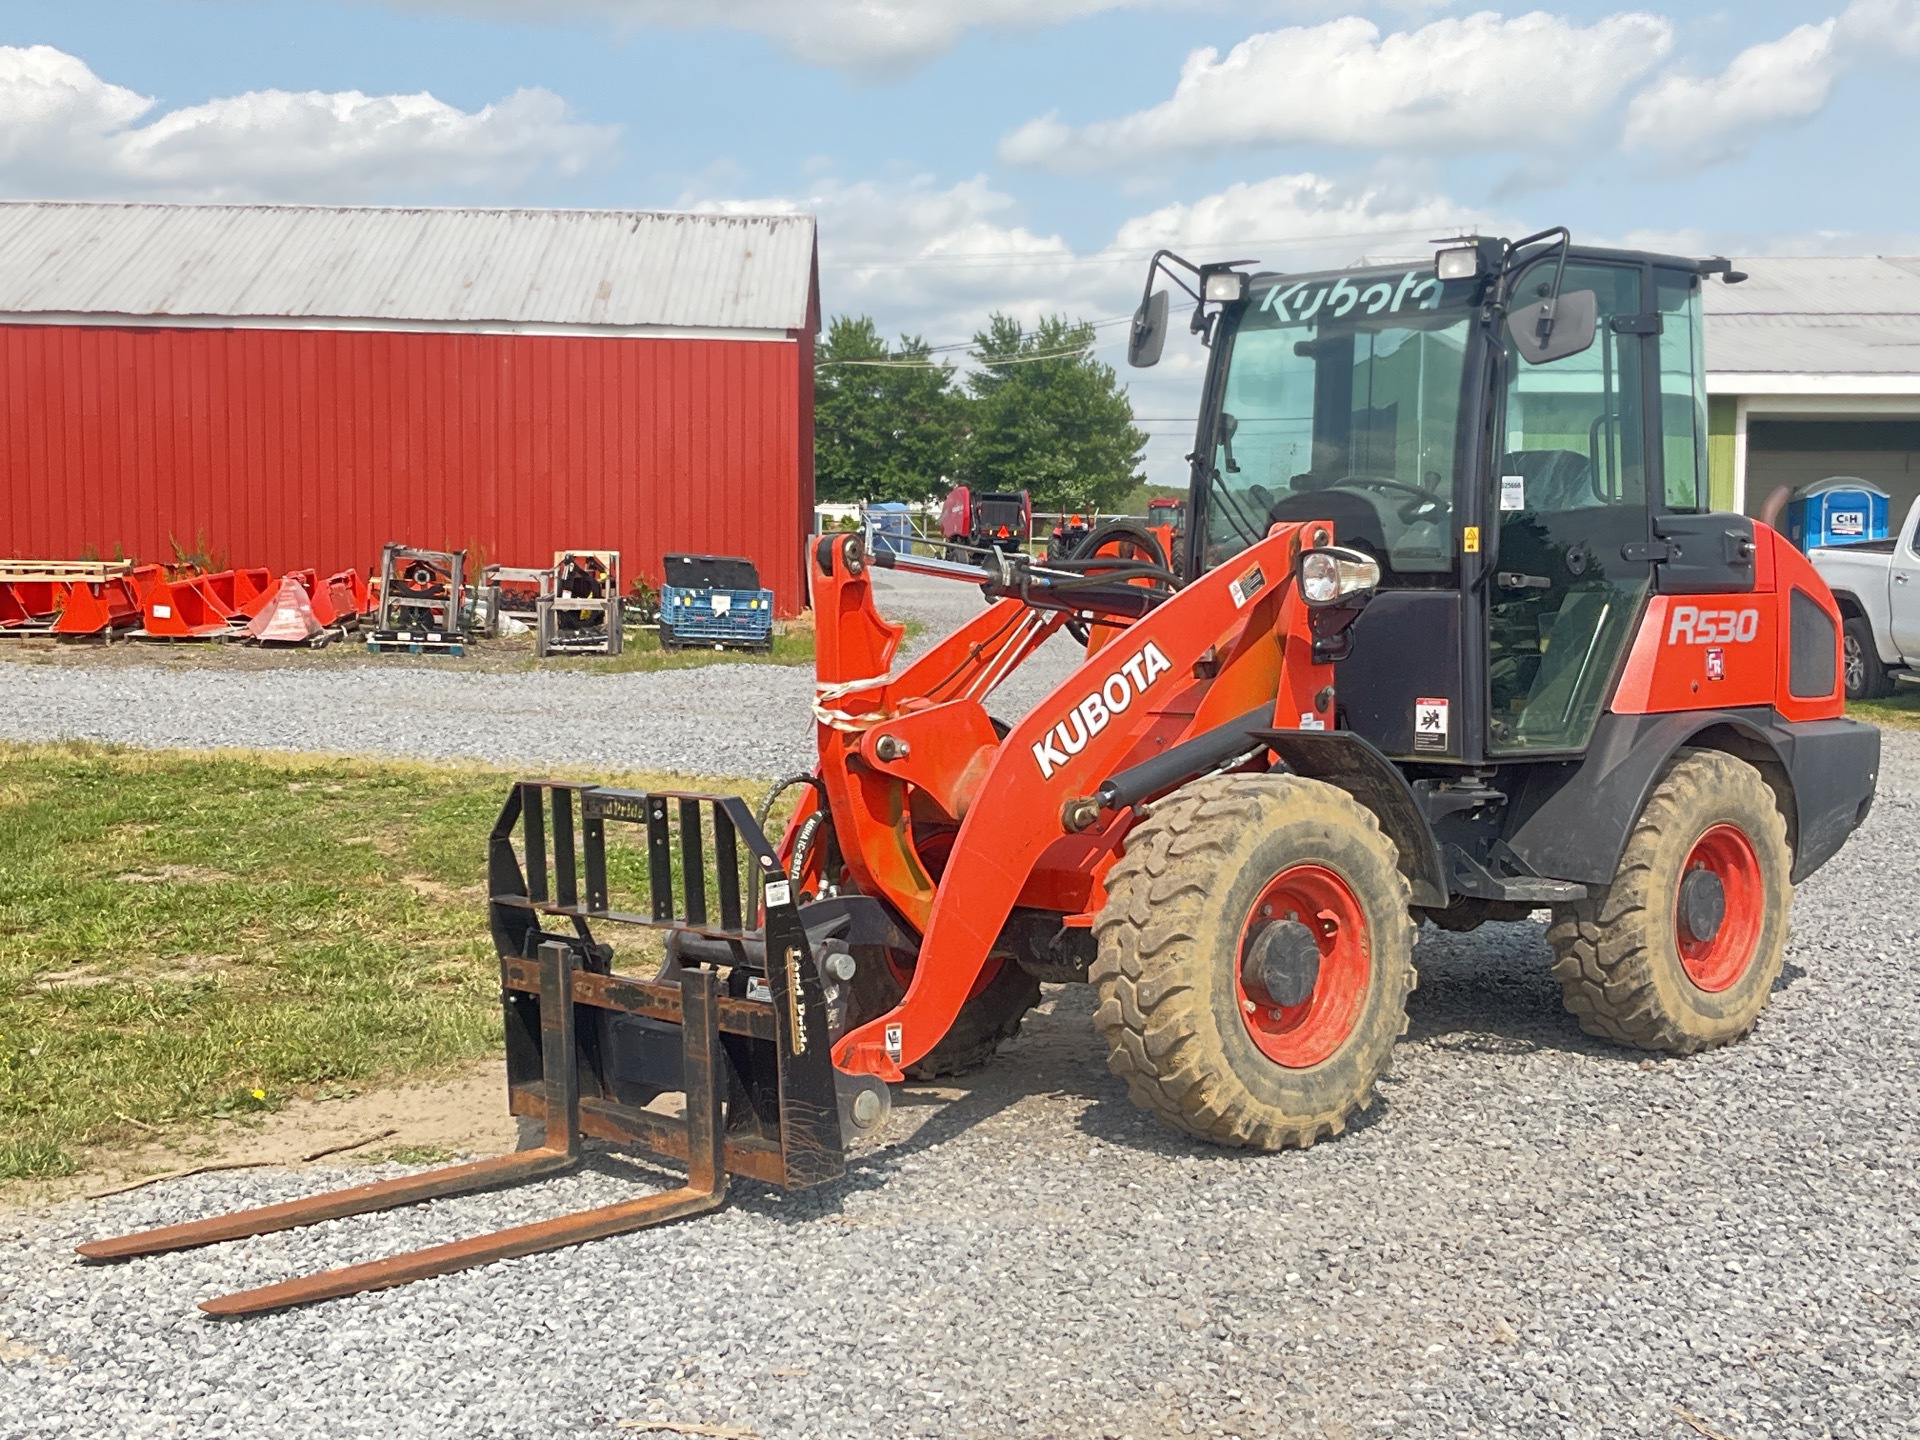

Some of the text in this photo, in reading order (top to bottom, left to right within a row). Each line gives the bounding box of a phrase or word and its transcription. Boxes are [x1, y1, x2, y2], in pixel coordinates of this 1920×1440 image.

[1260, 271, 1444, 322] Kubota
[1836, 514, 1857, 523] C&H
[1668, 606, 1759, 645] R530
[1031, 640, 1173, 781] KUBOTA
[800, 818, 816, 840] MSHA
[797, 1002, 808, 1053] Pride
